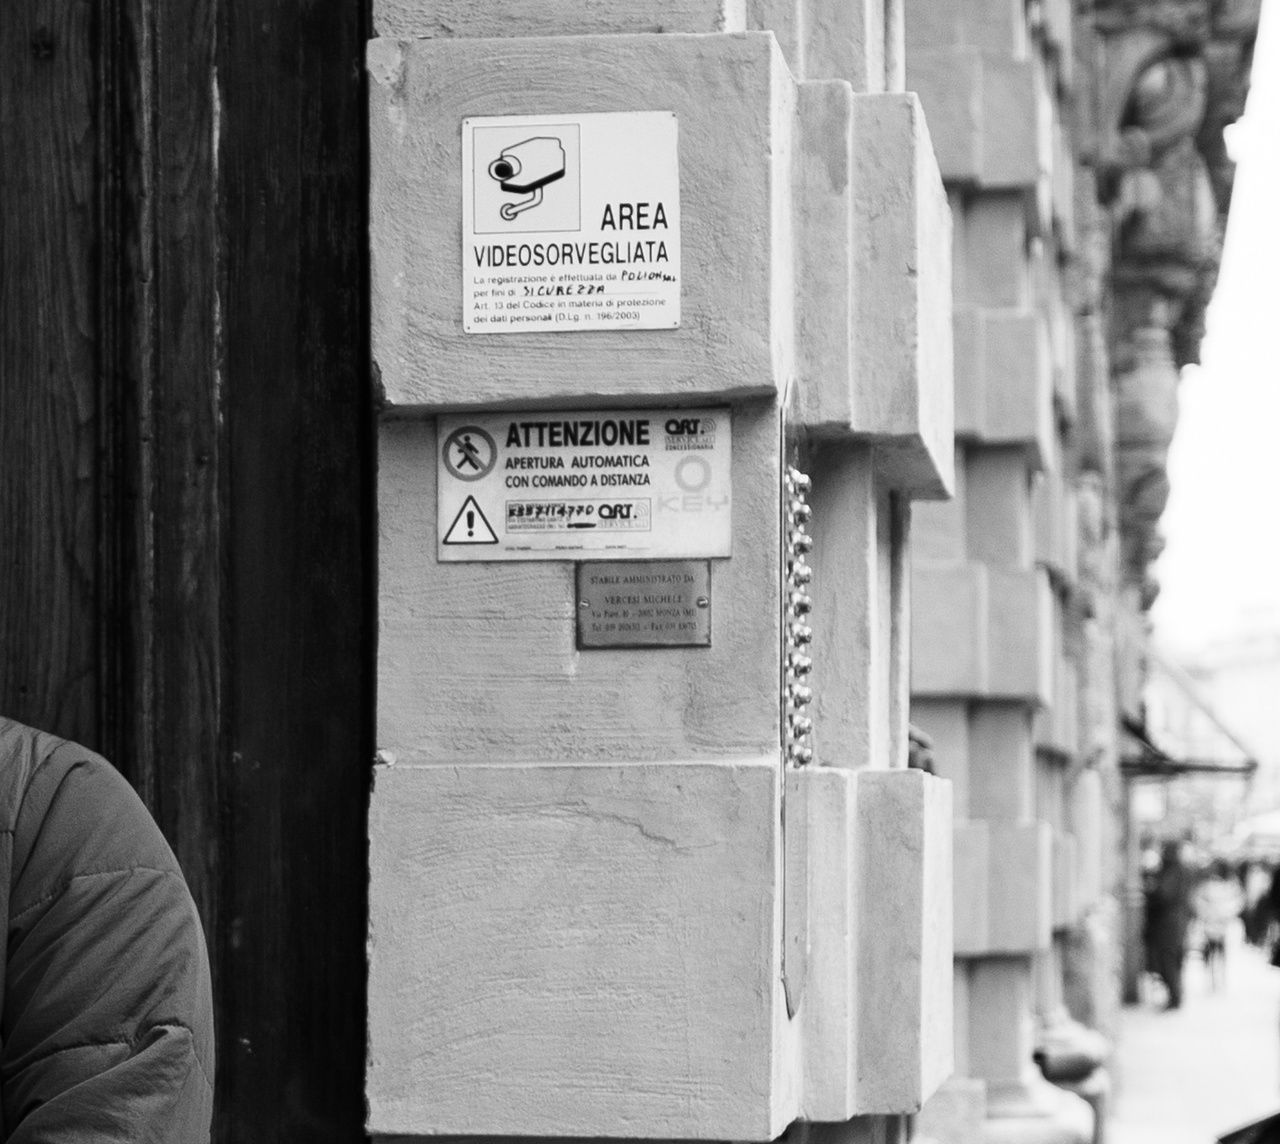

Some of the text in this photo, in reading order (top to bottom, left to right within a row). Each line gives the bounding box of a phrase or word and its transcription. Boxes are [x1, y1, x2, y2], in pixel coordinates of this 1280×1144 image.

[601, 202, 668, 231] AREA
[473, 241, 669, 267] VIDEOSORVEGLIATA
[488, 275, 548, 286] registrazione
[558, 273, 603, 282] effettuata
[473, 290, 489, 299] per
[506, 301, 520, 309] del
[522, 300, 555, 309] Codice
[558, 300, 566, 308] in
[569, 299, 603, 308] materia
[606, 299, 614, 307] di
[617, 298, 667, 308] protezione
[474, 315, 488, 323] dei
[490, 314, 507, 323] dati
[597, 311, 641, 321] 196/2003)
[505, 419, 650, 448] ATTENZIONE
[505, 454, 650, 470] APERTURA AUTOMATICA
[505, 472, 651, 489] CON COMANDO A DISTANZA
